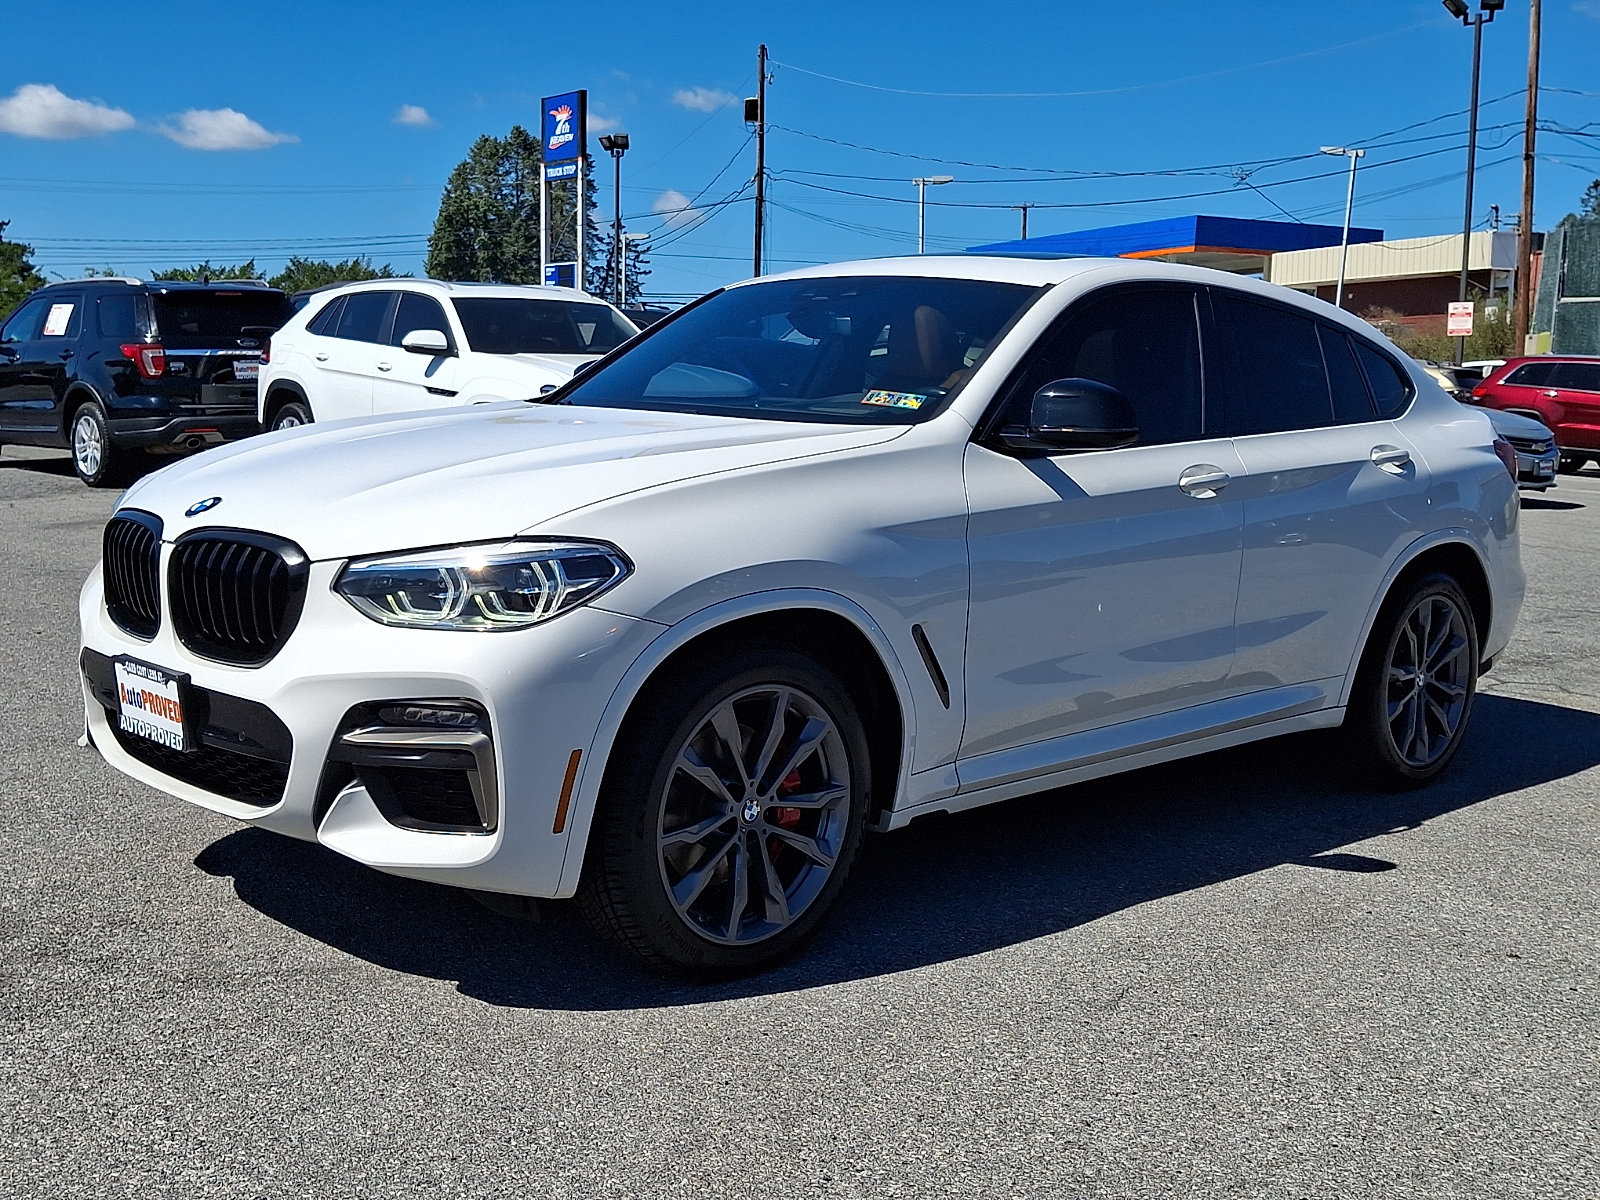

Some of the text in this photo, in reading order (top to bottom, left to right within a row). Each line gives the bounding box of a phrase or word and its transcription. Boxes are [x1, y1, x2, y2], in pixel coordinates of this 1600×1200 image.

[555, 113, 571, 135] 7th
[547, 164, 576, 178] TRUCK STOP
[120, 682, 184, 724] AutoPROVED
[120, 714, 184, 751] AUTOPROVED
